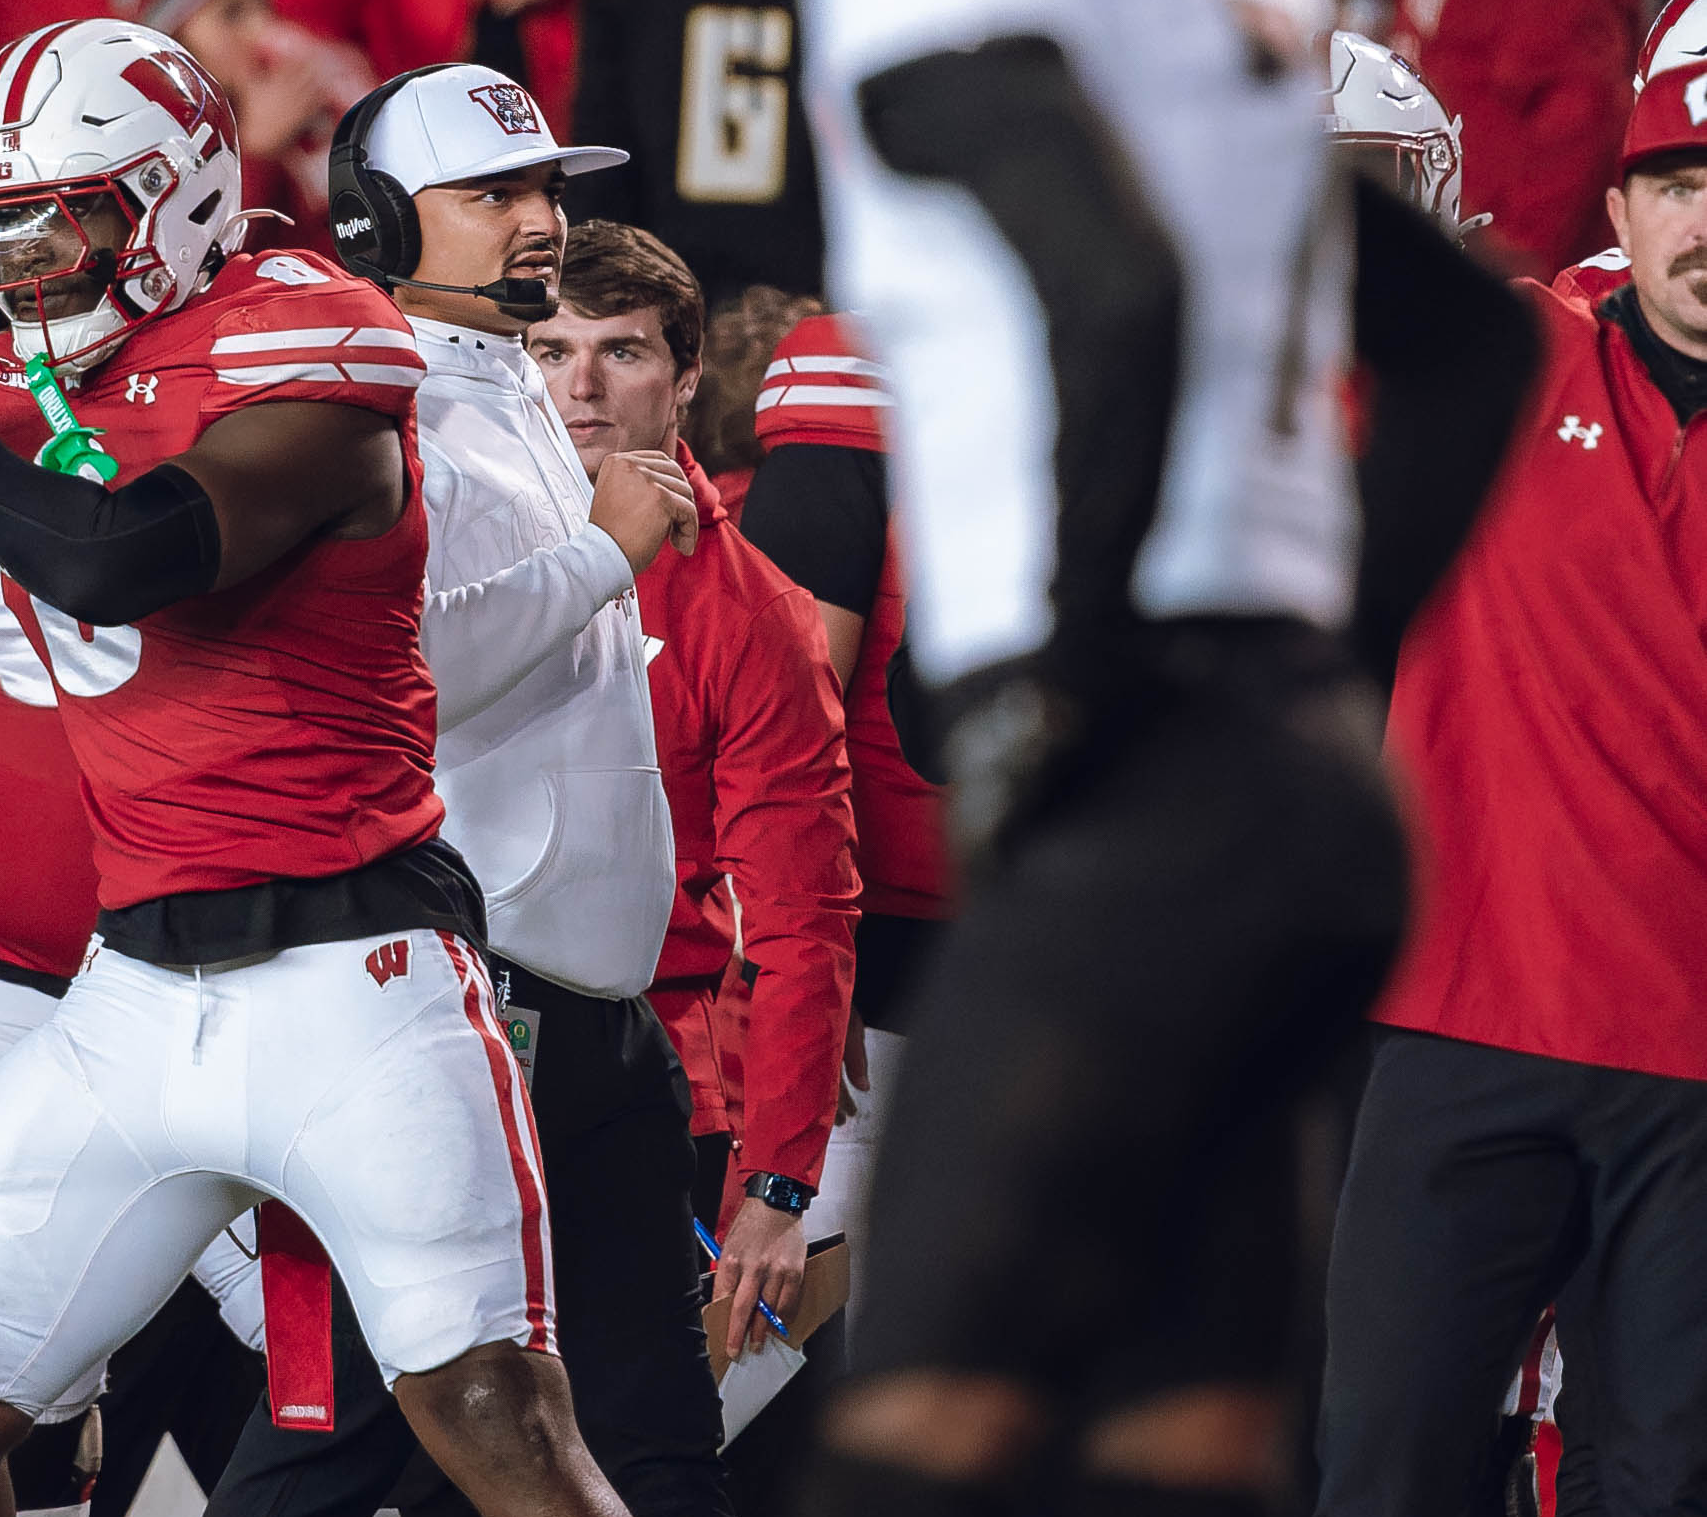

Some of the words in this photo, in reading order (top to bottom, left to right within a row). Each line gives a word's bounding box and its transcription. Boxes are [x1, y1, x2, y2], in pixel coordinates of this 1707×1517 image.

[467, 83, 542, 135] W
[675, 3, 794, 205] 6
[364, 938, 410, 989] W
